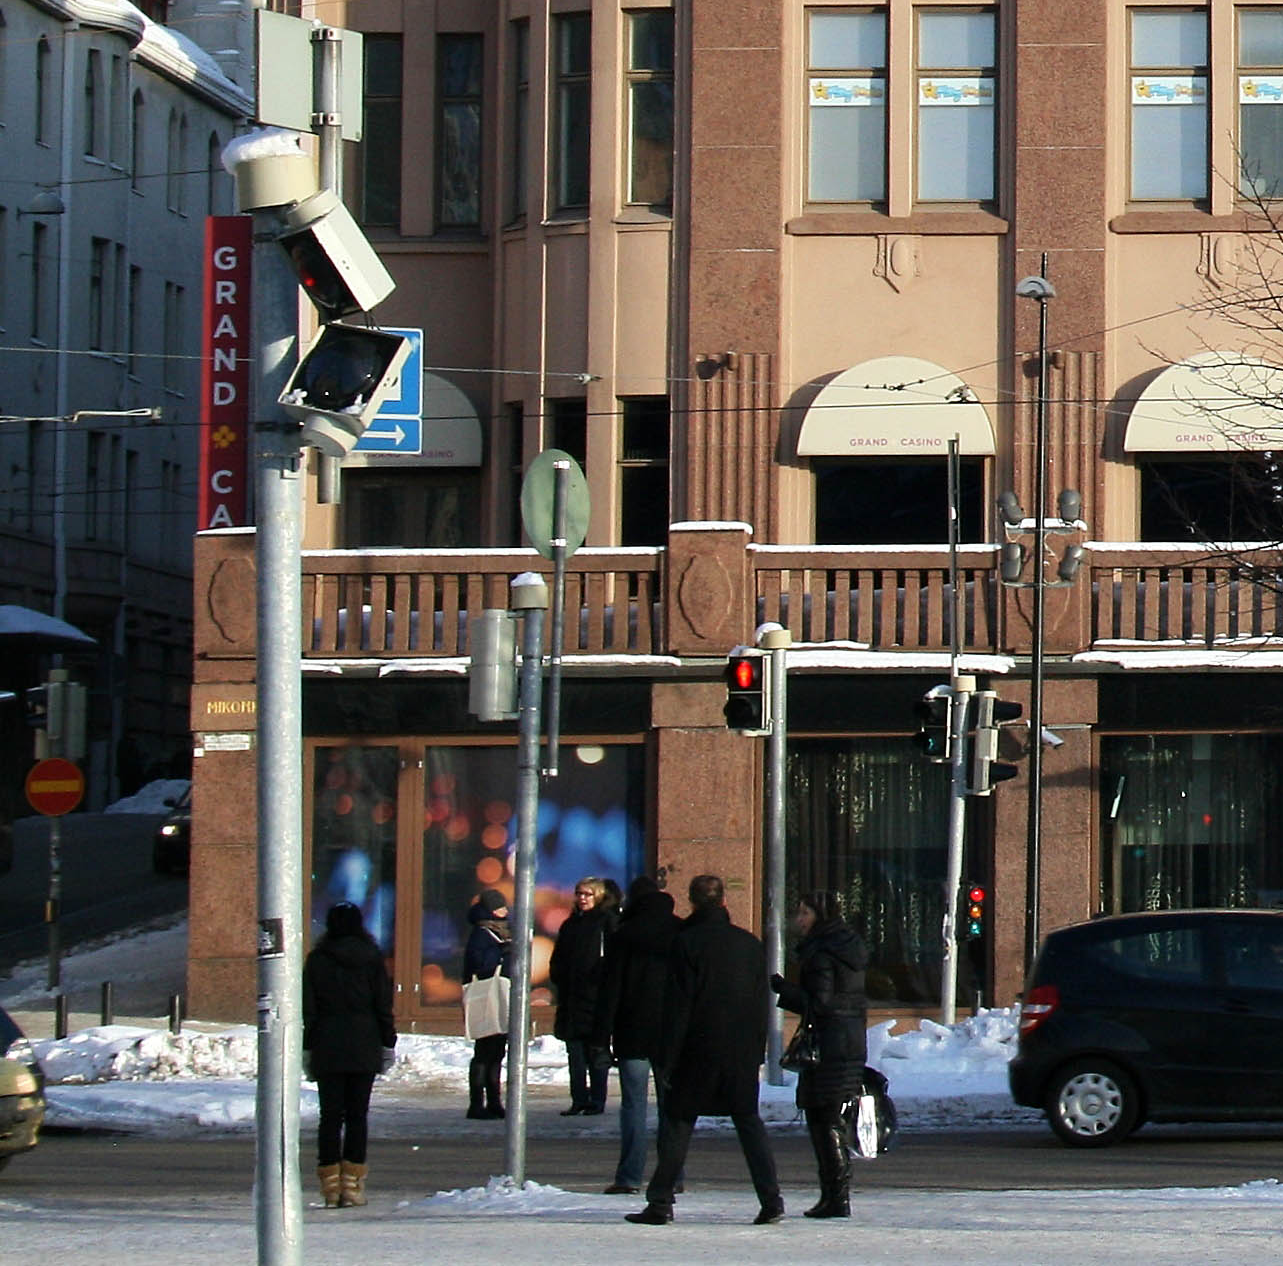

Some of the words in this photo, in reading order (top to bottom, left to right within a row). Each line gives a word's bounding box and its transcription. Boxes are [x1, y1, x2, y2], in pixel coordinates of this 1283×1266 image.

[212, 245, 238, 406] GRAND
[848, 437, 889, 447] GRAND
[899, 437, 943, 447] CASINO
[1175, 433, 1214, 443] GRAND
